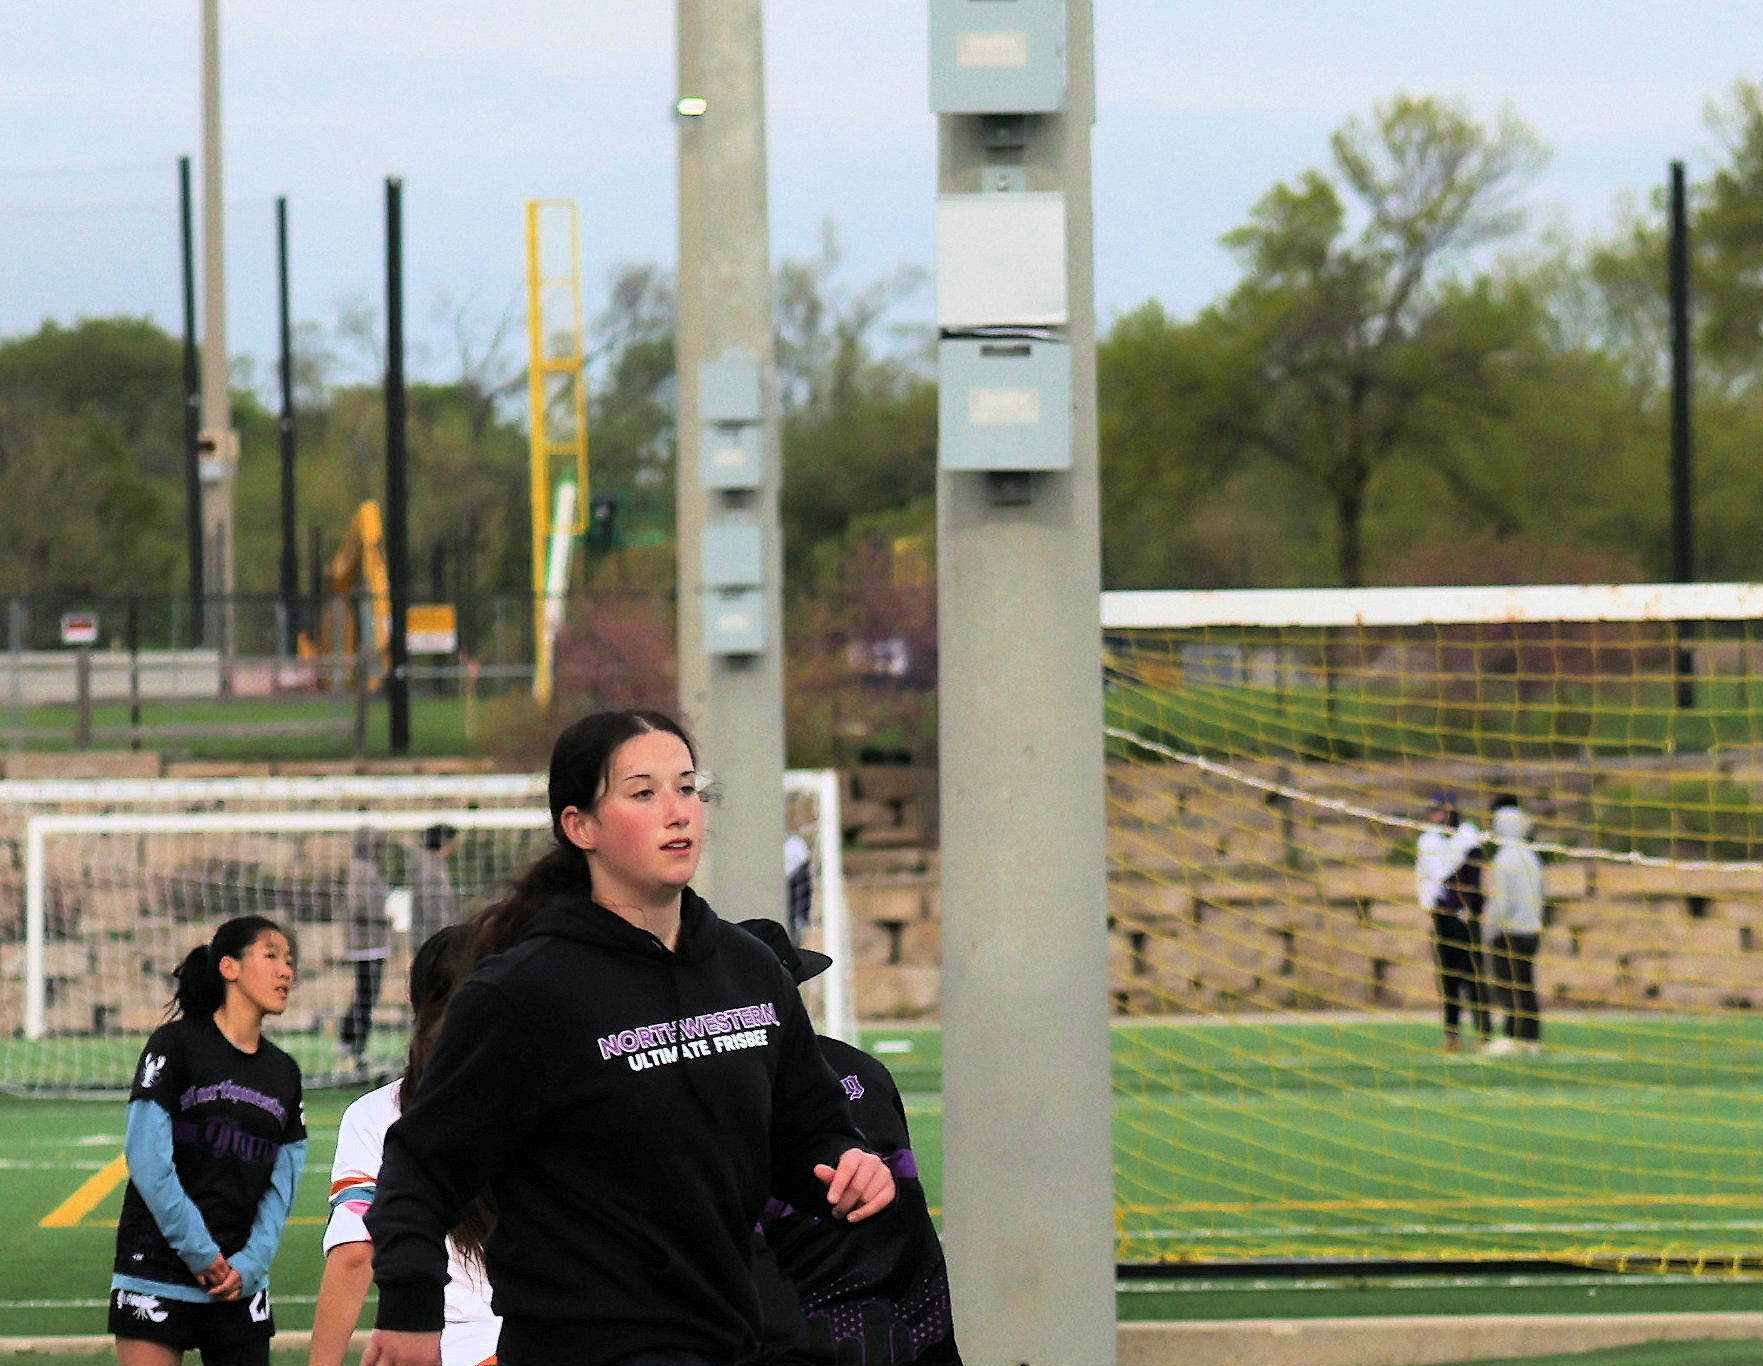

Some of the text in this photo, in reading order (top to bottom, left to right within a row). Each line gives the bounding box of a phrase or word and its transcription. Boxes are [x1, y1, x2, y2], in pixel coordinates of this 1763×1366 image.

[597, 1003, 780, 1060] NORTHWESTERN
[628, 1029, 768, 1072] ULTIMATE FRISBEE
